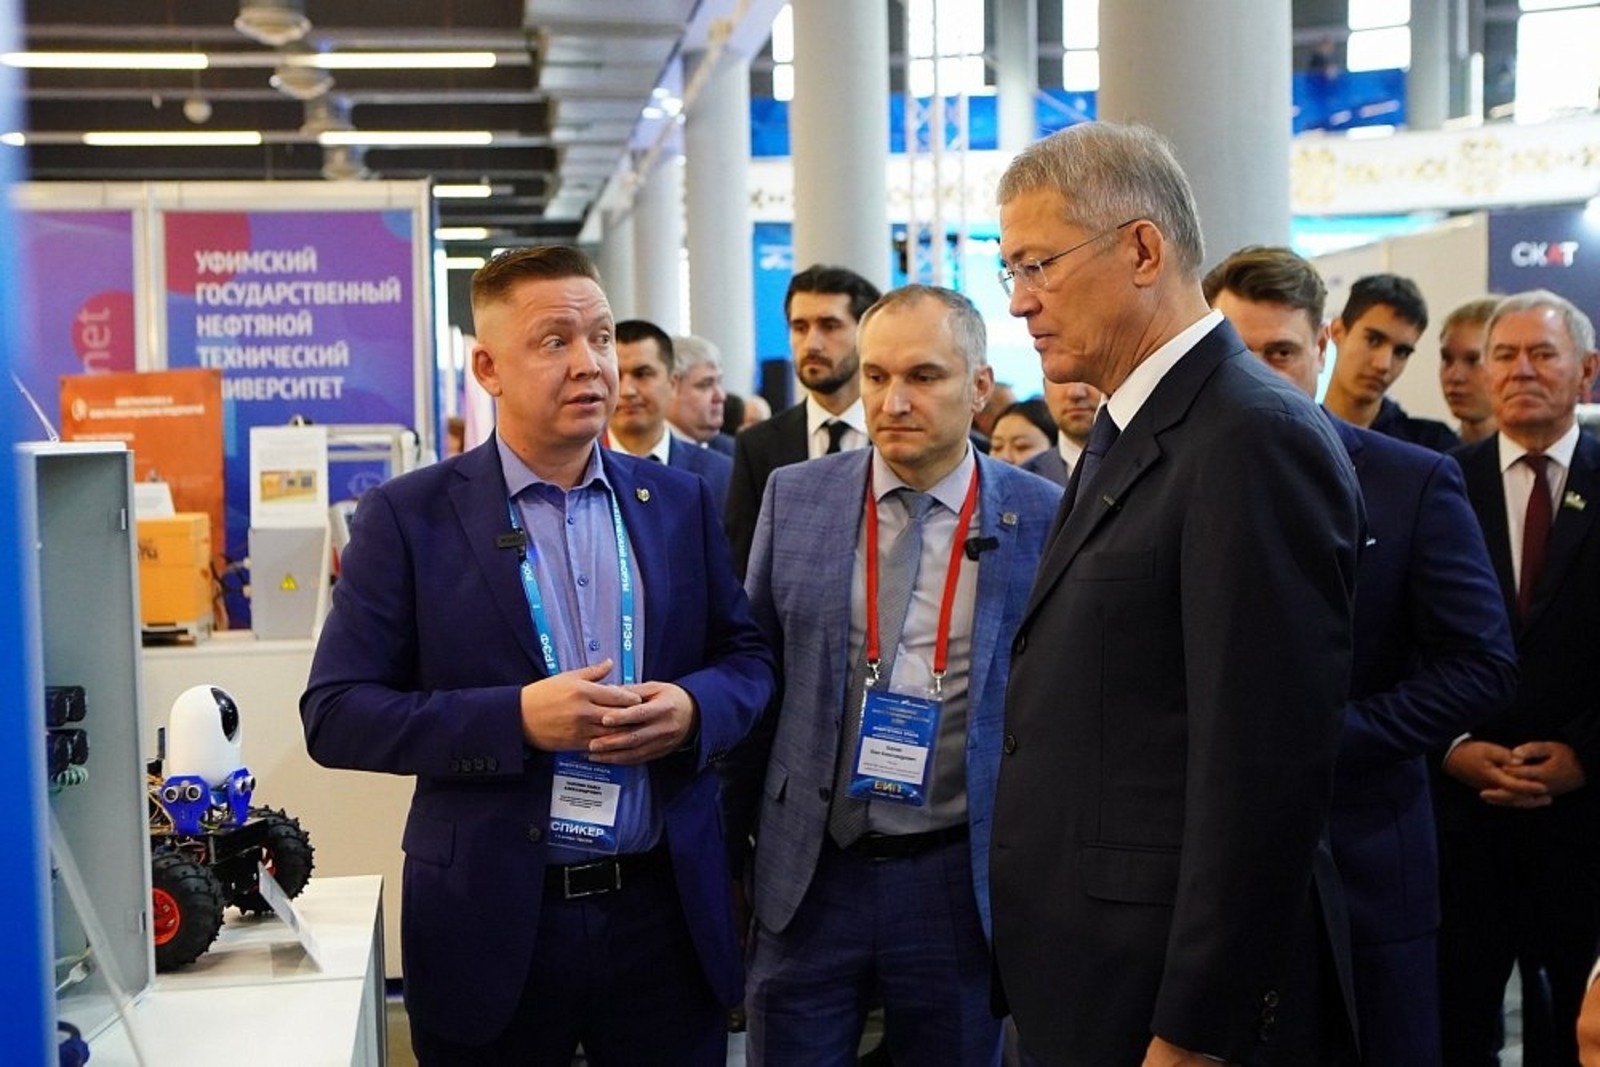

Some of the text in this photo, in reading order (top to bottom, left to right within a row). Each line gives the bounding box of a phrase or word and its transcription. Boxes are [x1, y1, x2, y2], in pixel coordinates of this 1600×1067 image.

[195, 246, 317, 273] УФИМСКИЙ
[196, 276, 401, 306] ГОСУДАРСТВЕННЫЙ
[197, 310, 313, 336] НЕФТЯНОЙ
[78, 306, 111, 375] net
[197, 340, 349, 369] ТЕХНИЧЕСКИЙ
[222, 376, 343, 400] ИВЕРСИТЕТ
[551, 821, 605, 837] СПИКЕР
